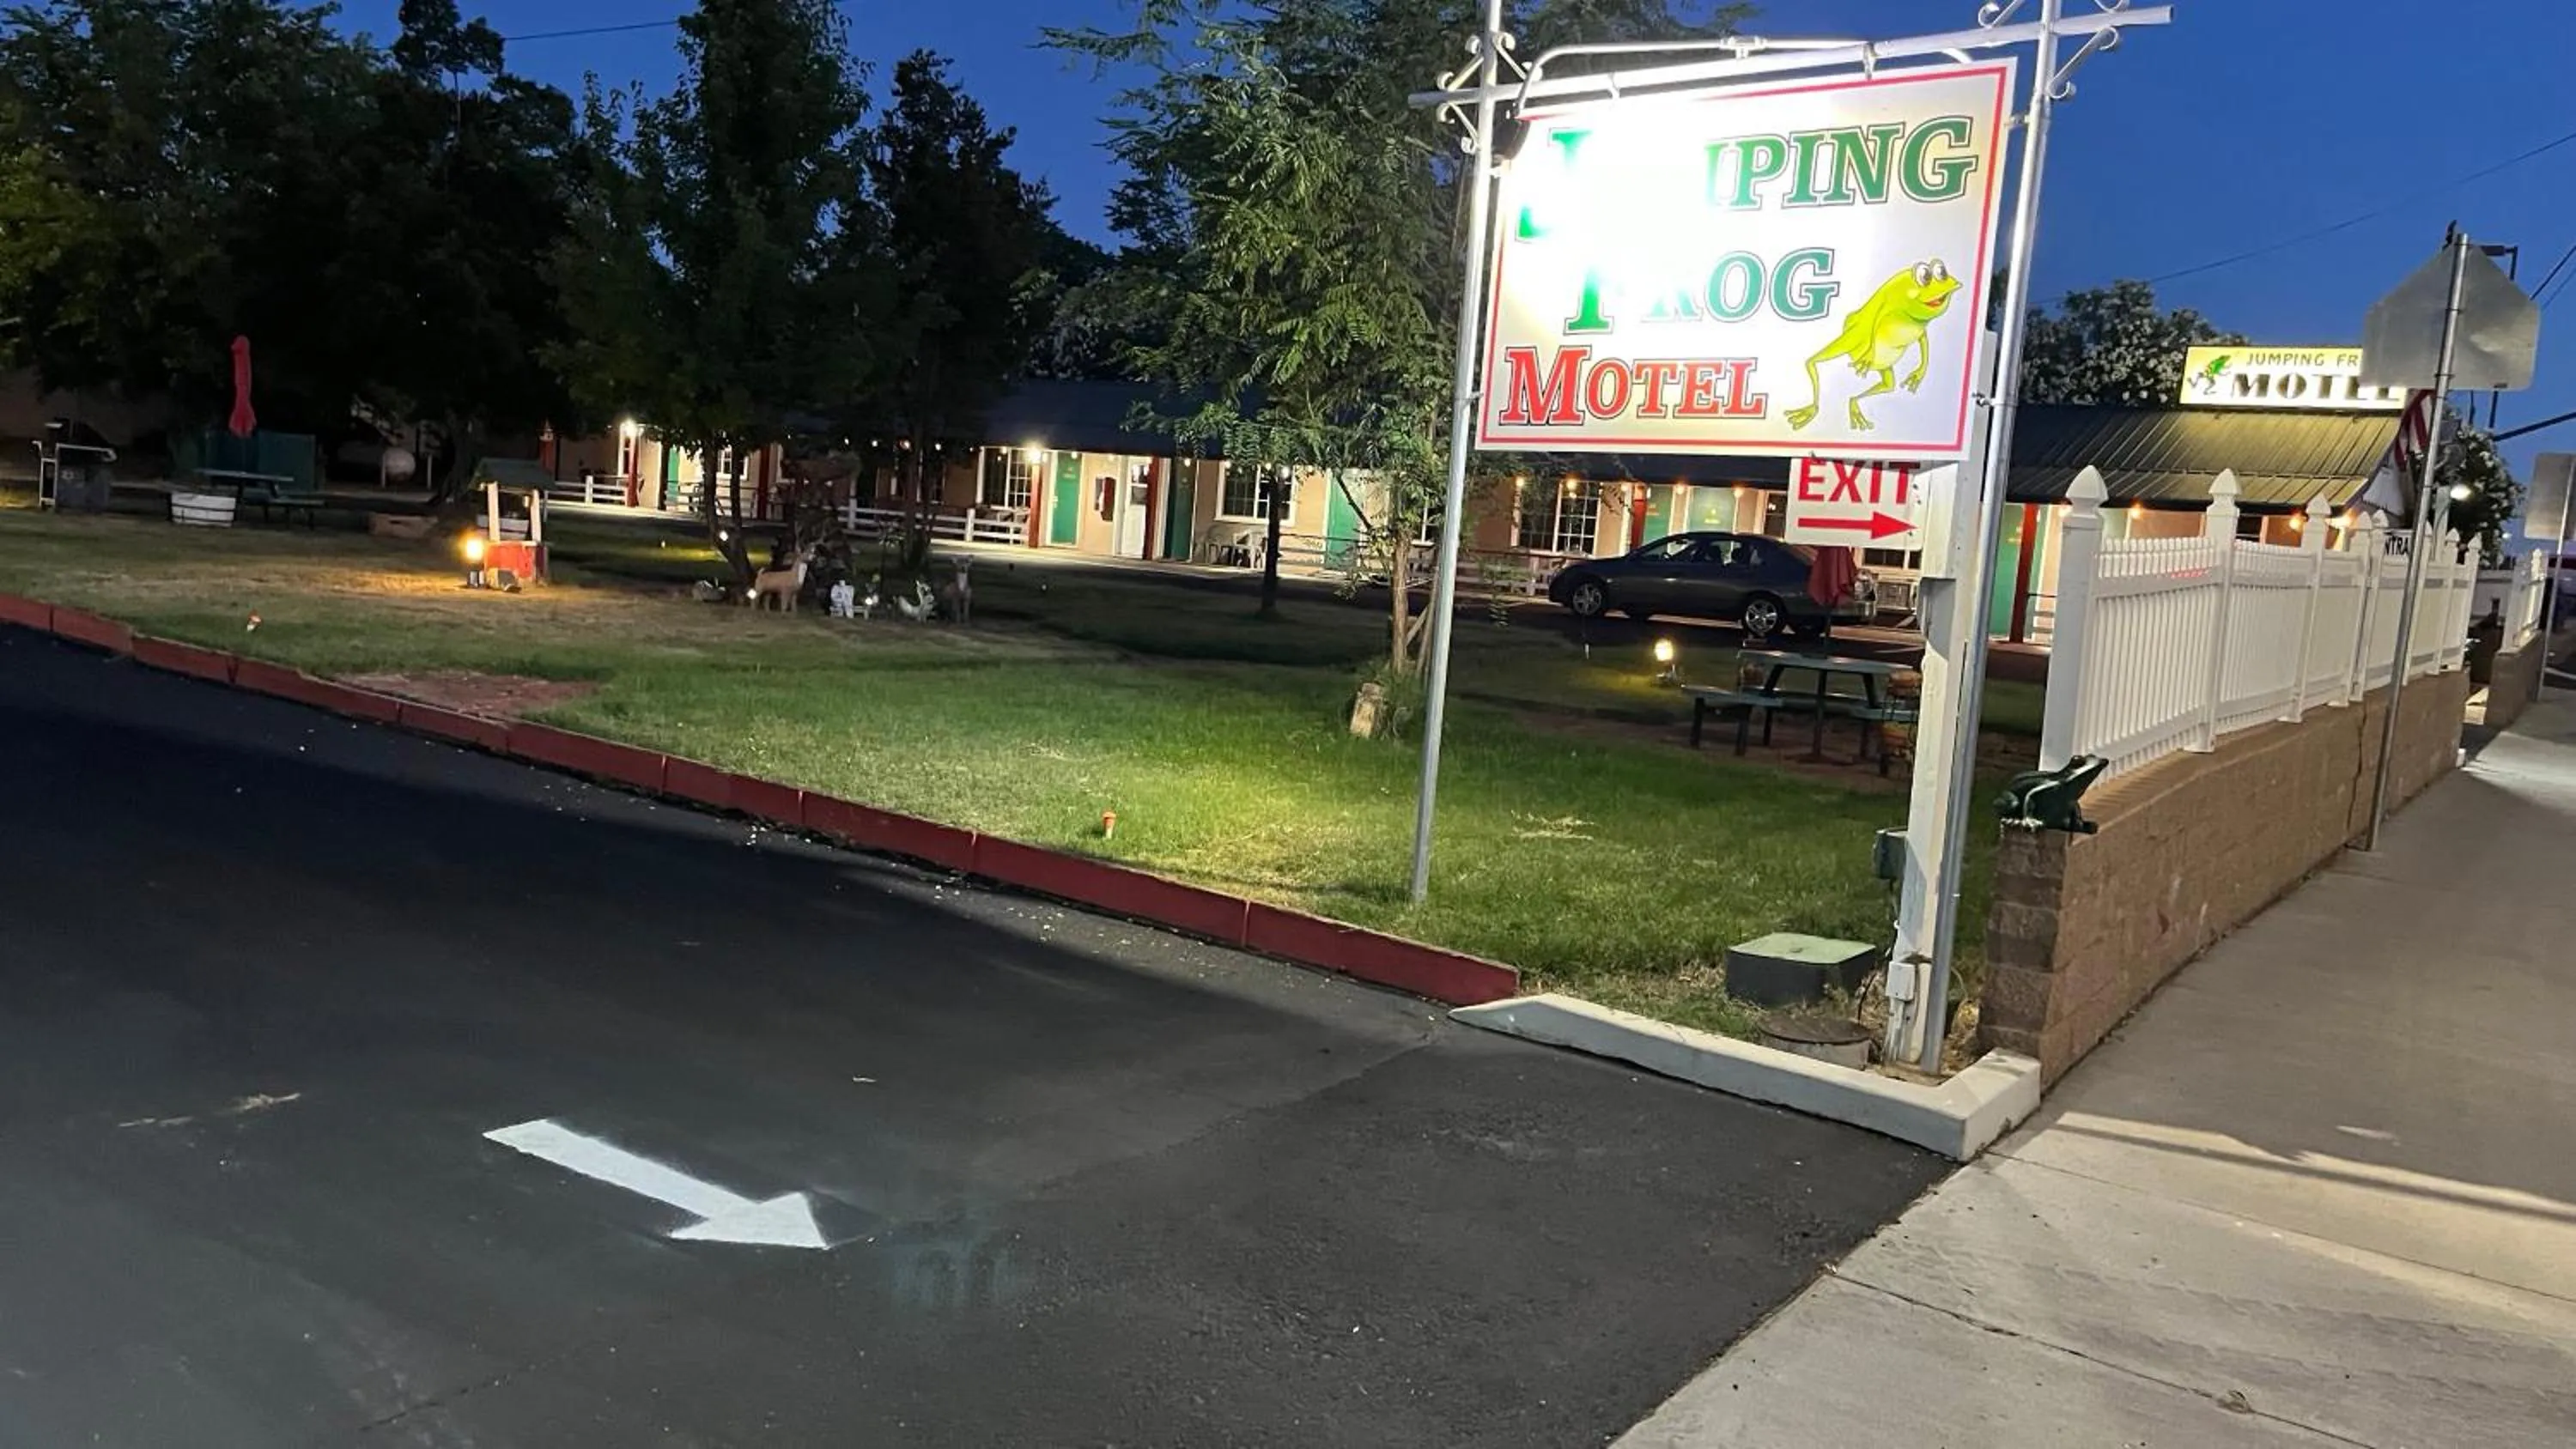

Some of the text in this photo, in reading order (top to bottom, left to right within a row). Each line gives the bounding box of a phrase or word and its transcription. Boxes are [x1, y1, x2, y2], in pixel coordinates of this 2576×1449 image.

[1515, 117, 1978, 243] PING
[1563, 248, 1839, 336] OG
[1499, 345, 1768, 426] MOTEL
[2246, 353, 2359, 368] JUMPING FR
[1798, 457, 1921, 504] EXIT
[2385, 536, 2409, 555] NTRA
